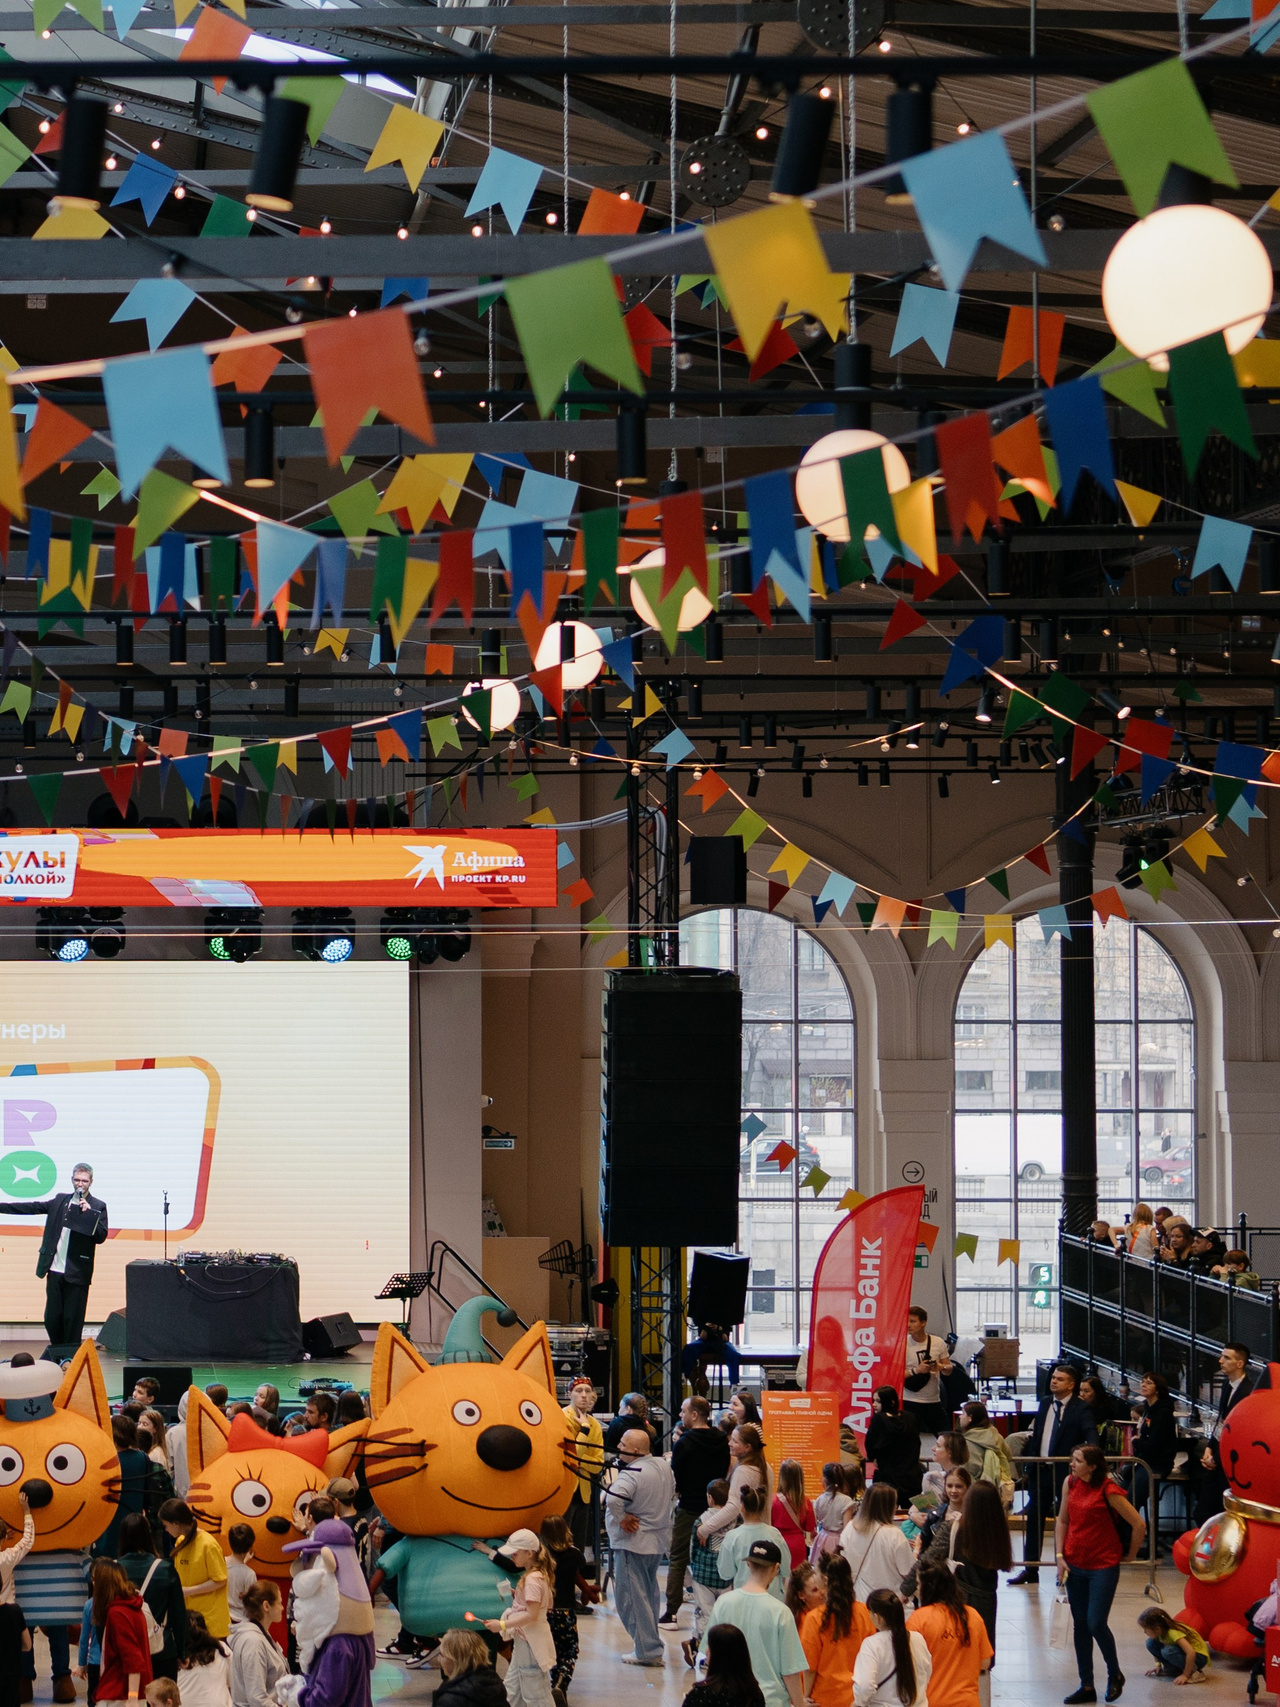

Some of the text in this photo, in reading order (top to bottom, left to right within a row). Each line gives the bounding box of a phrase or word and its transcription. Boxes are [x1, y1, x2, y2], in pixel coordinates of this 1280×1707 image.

[451, 851, 526, 872] Афиша
[451, 875, 493, 883] ПРОЕКТ
[843, 1236, 883, 1435] Альфа Банк
